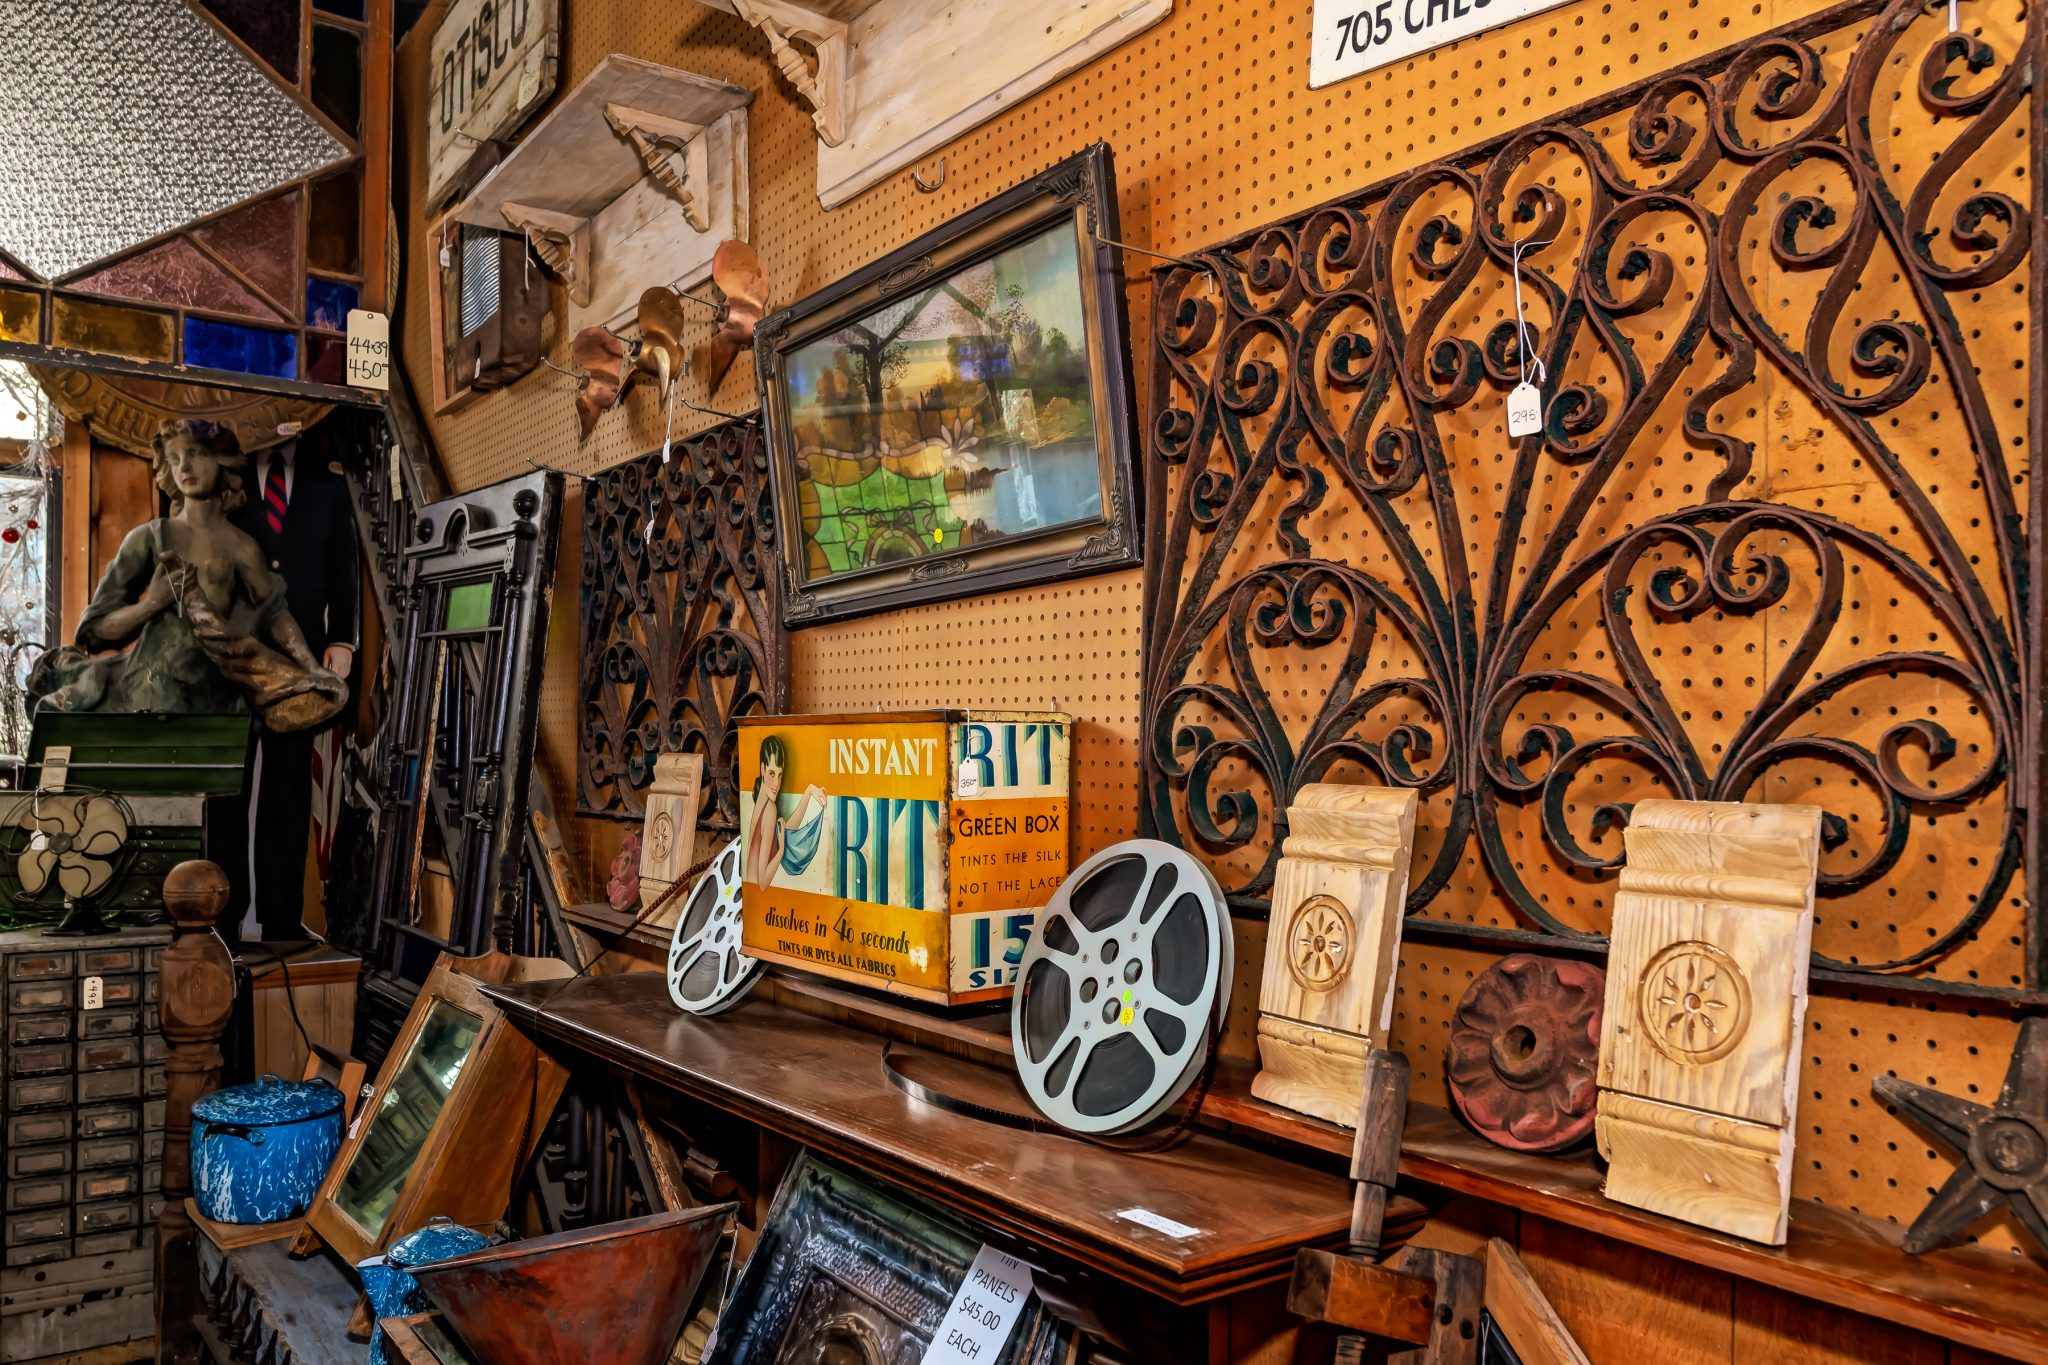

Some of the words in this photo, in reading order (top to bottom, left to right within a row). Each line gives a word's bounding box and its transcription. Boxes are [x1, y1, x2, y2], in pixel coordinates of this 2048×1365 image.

[1335, 1, 1393, 61] 705
[1404, 0, 1492, 34] CH
[829, 738, 938, 777] INSTANT
[956, 724, 1064, 788] RIT
[958, 817, 1017, 837] GREEN
[1025, 815, 1060, 834] BOX
[832, 795, 940, 911] RIT
[960, 854, 996, 867] TINTS
[1005, 852, 1027, 864] THE
[1036, 850, 1061, 862] SILK
[959, 882, 988, 895] NOT
[997, 879, 1021, 892] THE
[1030, 876, 1062, 890] LACE
[765, 906, 809, 934] dissolves
[814, 915, 827, 938] in
[832, 906, 855, 944] 40
[860, 931, 911, 955] seconds
[777, 939, 800, 955] TINTS
[802, 945, 814, 959] OR
[815, 949, 836, 963] DYES
[837, 953, 854, 968] ALL
[856, 957, 896, 978] FABRICS
[972, 1268, 1018, 1303] PANELS
[959, 1295, 1001, 1331] $45.00
[946, 1328, 981, 1360] EACH
